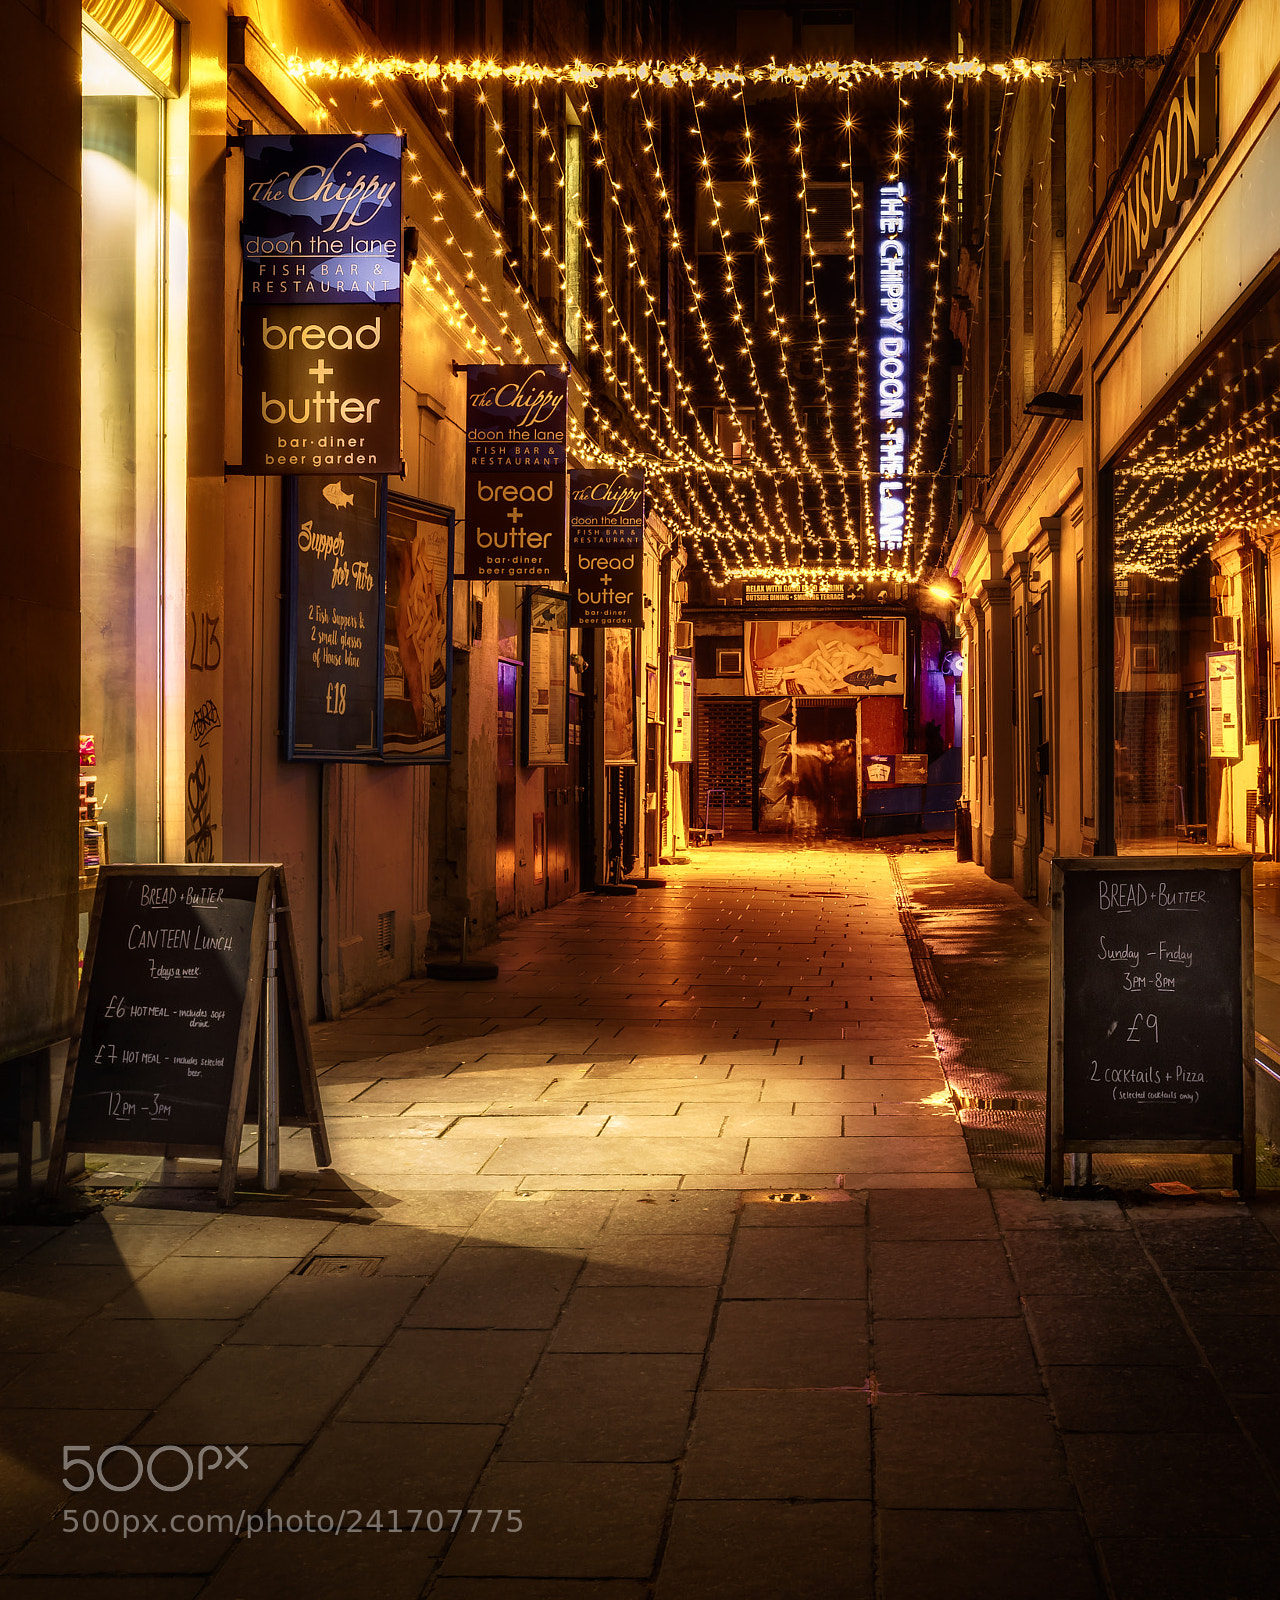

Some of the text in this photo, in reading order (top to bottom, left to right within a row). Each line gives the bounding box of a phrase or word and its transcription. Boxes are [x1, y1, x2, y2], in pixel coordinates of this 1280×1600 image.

[248, 143, 396, 233] The Chippy
[1104, 52, 1206, 303] MONSOON
[246, 236, 397, 254] doon the lane
[259, 264, 383, 276] FISH BAR &
[252, 280, 390, 293] RESTAURANT
[262, 316, 381, 350] bread
[308, 359, 334, 384] +
[878, 181, 905, 550] THE CHIPPY DOON THE LANE
[261, 390, 381, 425] butter
[470, 369, 564, 427] The Chippy
[468, 428, 564, 441] doon the lane
[266, 452, 377, 468] beer garden
[471, 457, 560, 466] RESTAURANT
[476, 446, 556, 455] FISH BAR &
[477, 480, 553, 502] bread
[572, 473, 642, 516] The Chippy
[506, 506, 524, 524] +
[571, 516, 642, 526] doon the lane
[298, 518, 345, 561] Supper
[476, 526, 552, 549] butter
[478, 566, 550, 578] beer garden
[578, 554, 634, 570] bread
[330, 556, 374, 592] for Two
[599, 573, 612, 586] +
[577, 588, 634, 604] butter
[308, 604, 366, 630] 2 Fish Suppers &
[600, 617, 632, 626] garden
[310, 625, 362, 650] 2 small glasses
[312, 647, 360, 669] of House Wine
[326, 682, 348, 716] £18
[140, 884, 177, 907] BREAD
[1098, 880, 1148, 911] BREAD
[128, 924, 191, 950] CANTEEN
[1098, 935, 1140, 968] Sunday
[1159, 940, 1193, 968] Friday
[148, 958, 156, 978] 7
[156, 964, 175, 981] days
[175, 968, 181, 976] a
[104, 994, 126, 1018] £6
[130, 1005, 146, 1017] HOT
[148, 1006, 170, 1017] MEAL
[178, 1008, 208, 1018] includes
[210, 1010, 226, 1022] soft
[1126, 1012, 1160, 1044] £9
[94, 1044, 118, 1064] £7
[122, 1050, 139, 1064] HOT
[140, 1052, 162, 1064] MEAL
[173, 1056, 198, 1066] includes
[200, 1056, 225, 1068] selected
[1090, 1060, 1101, 1082] 2
[1104, 1066, 1161, 1084] cocktails
[1147, 1091, 1178, 1100] cocktails
